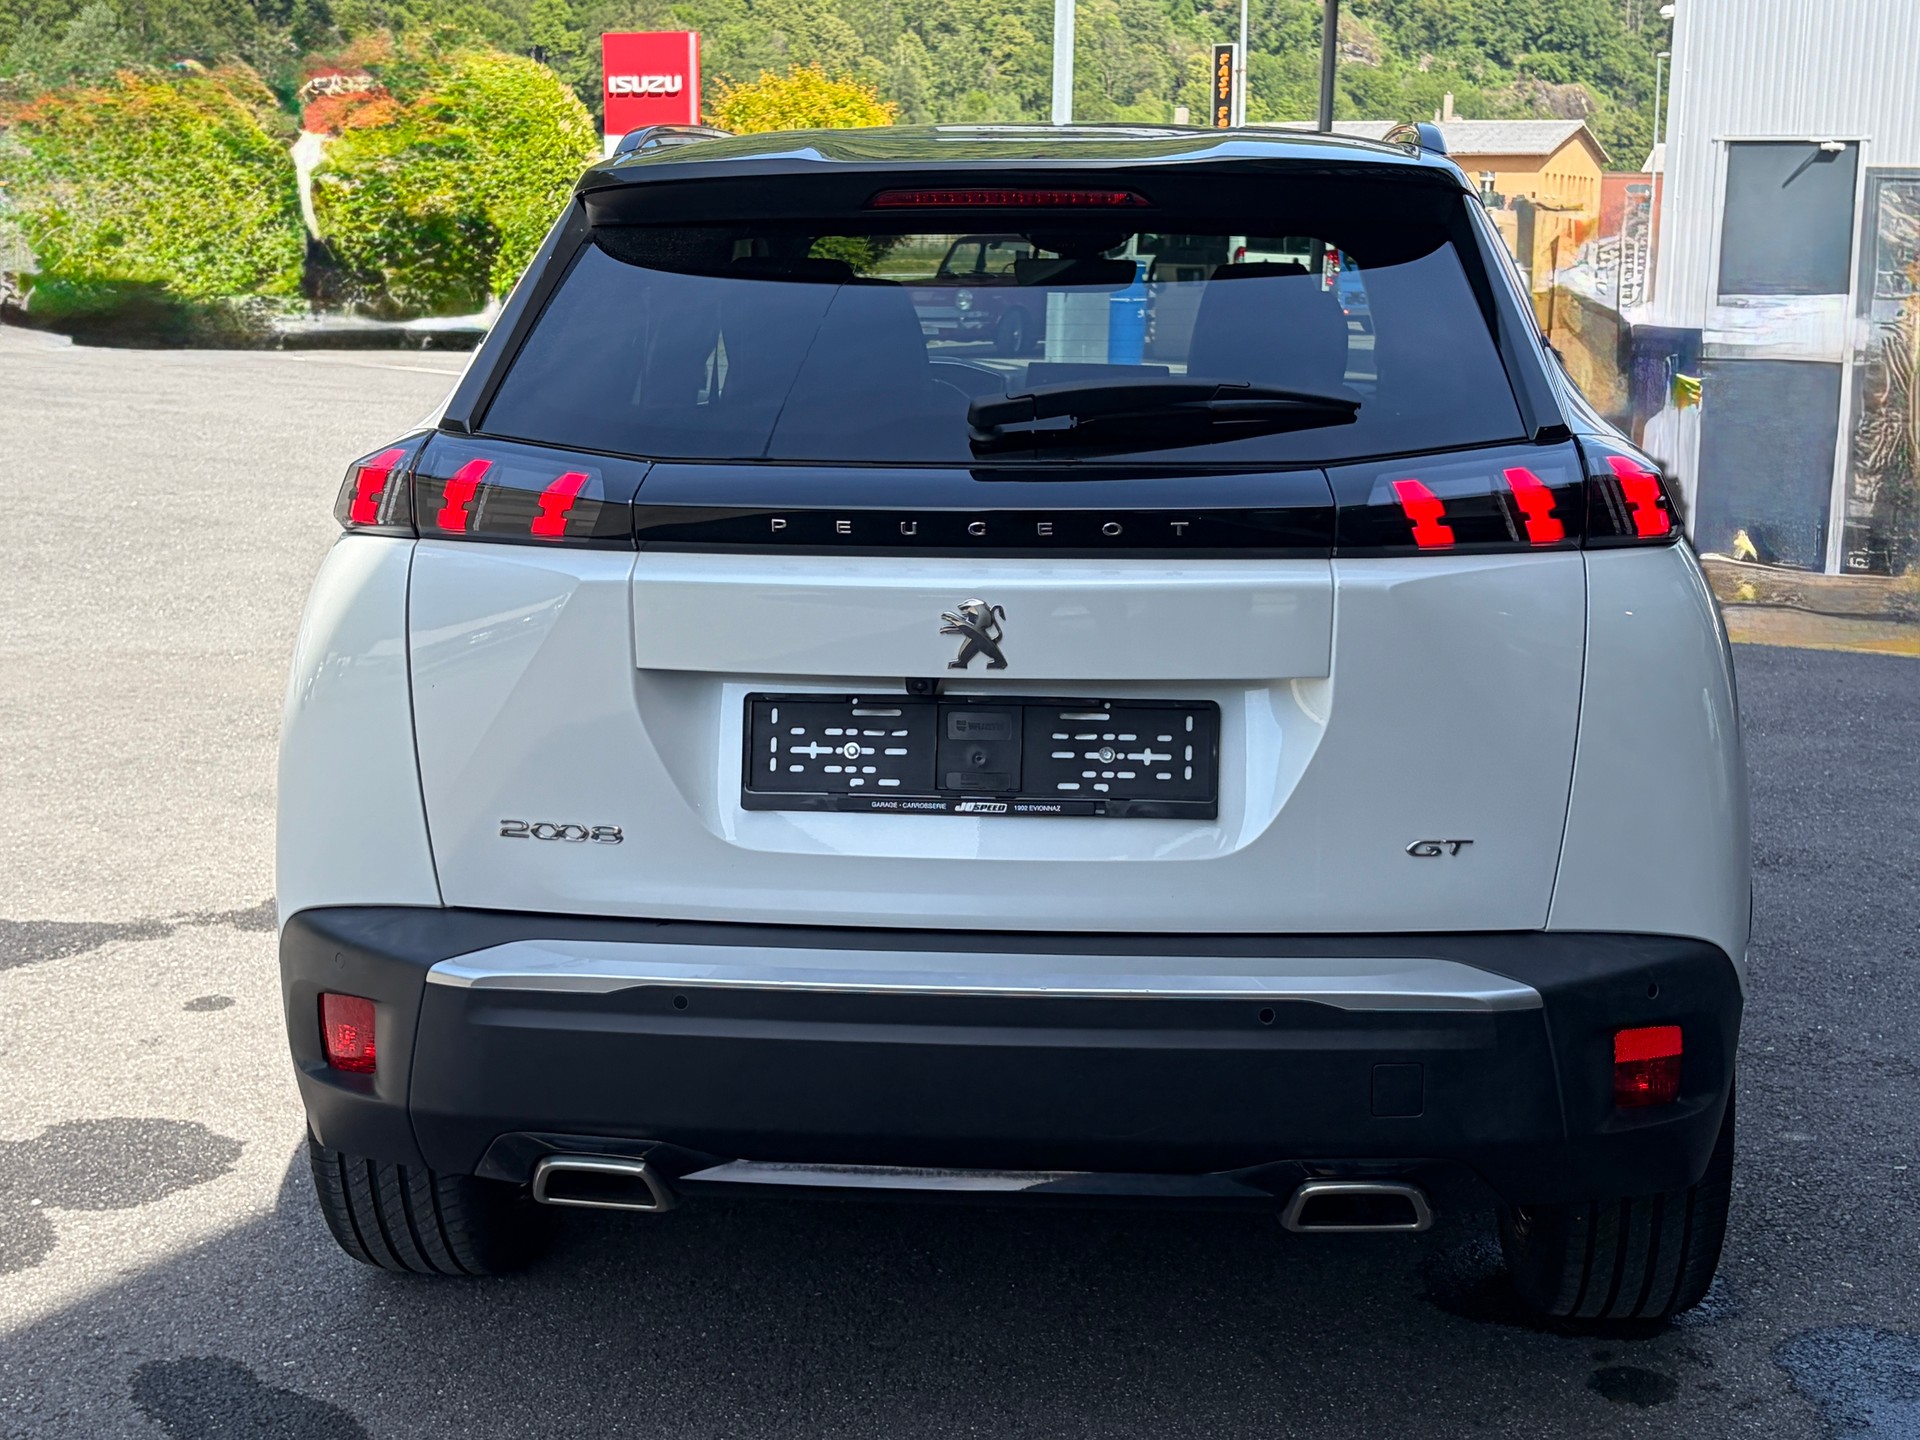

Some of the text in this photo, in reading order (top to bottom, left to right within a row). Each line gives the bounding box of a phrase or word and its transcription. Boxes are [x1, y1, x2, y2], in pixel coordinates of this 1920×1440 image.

[608, 75, 682, 94] ISUZU
[1218, 53, 1230, 99] FAST
[771, 518, 1190, 536] PEUGEOT
[871, 801, 898, 809] GARAGE
[500, 819, 624, 844] 2008
[1405, 839, 1474, 857] GT
